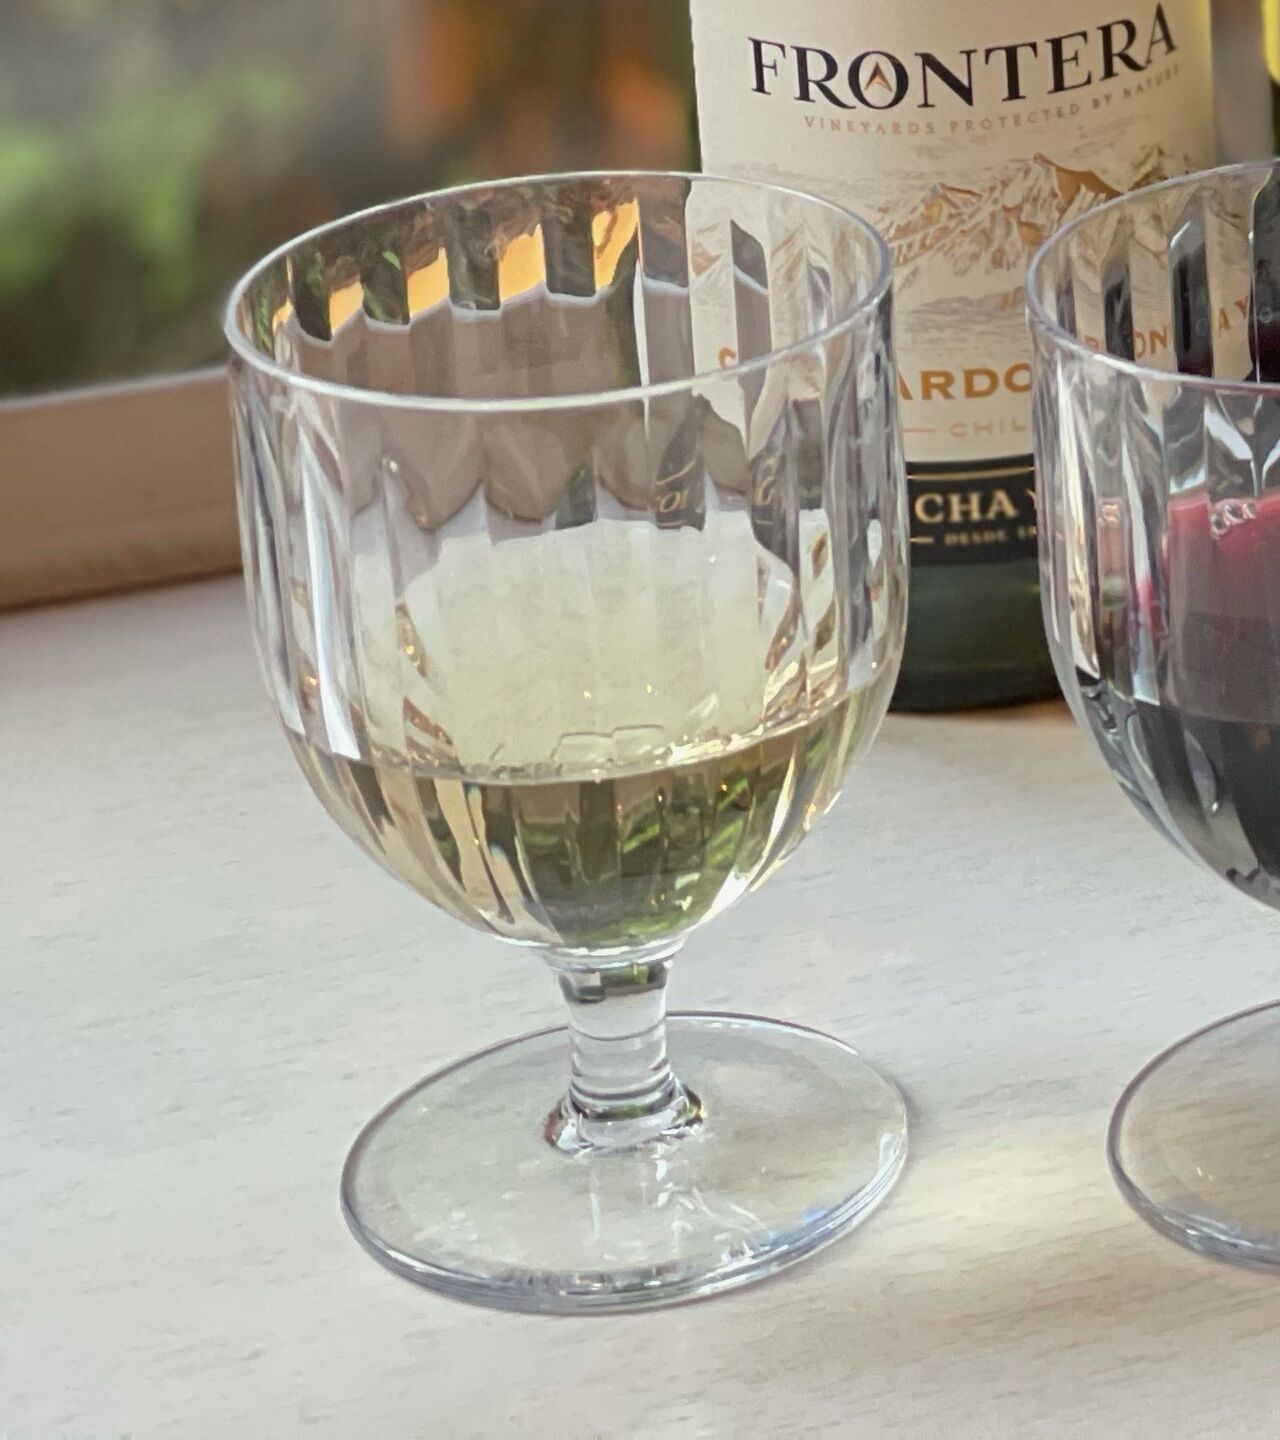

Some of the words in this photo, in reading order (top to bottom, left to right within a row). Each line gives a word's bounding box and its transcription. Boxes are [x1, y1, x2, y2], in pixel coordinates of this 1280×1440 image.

[747, 2, 1179, 110] FRONTERA
[805, 116, 935, 135] VINEYARDS
[949, 103, 1080, 133] PROTECTED
[1092, 93, 1113, 110] BY
[1123, 64, 1179, 100] NATURE
